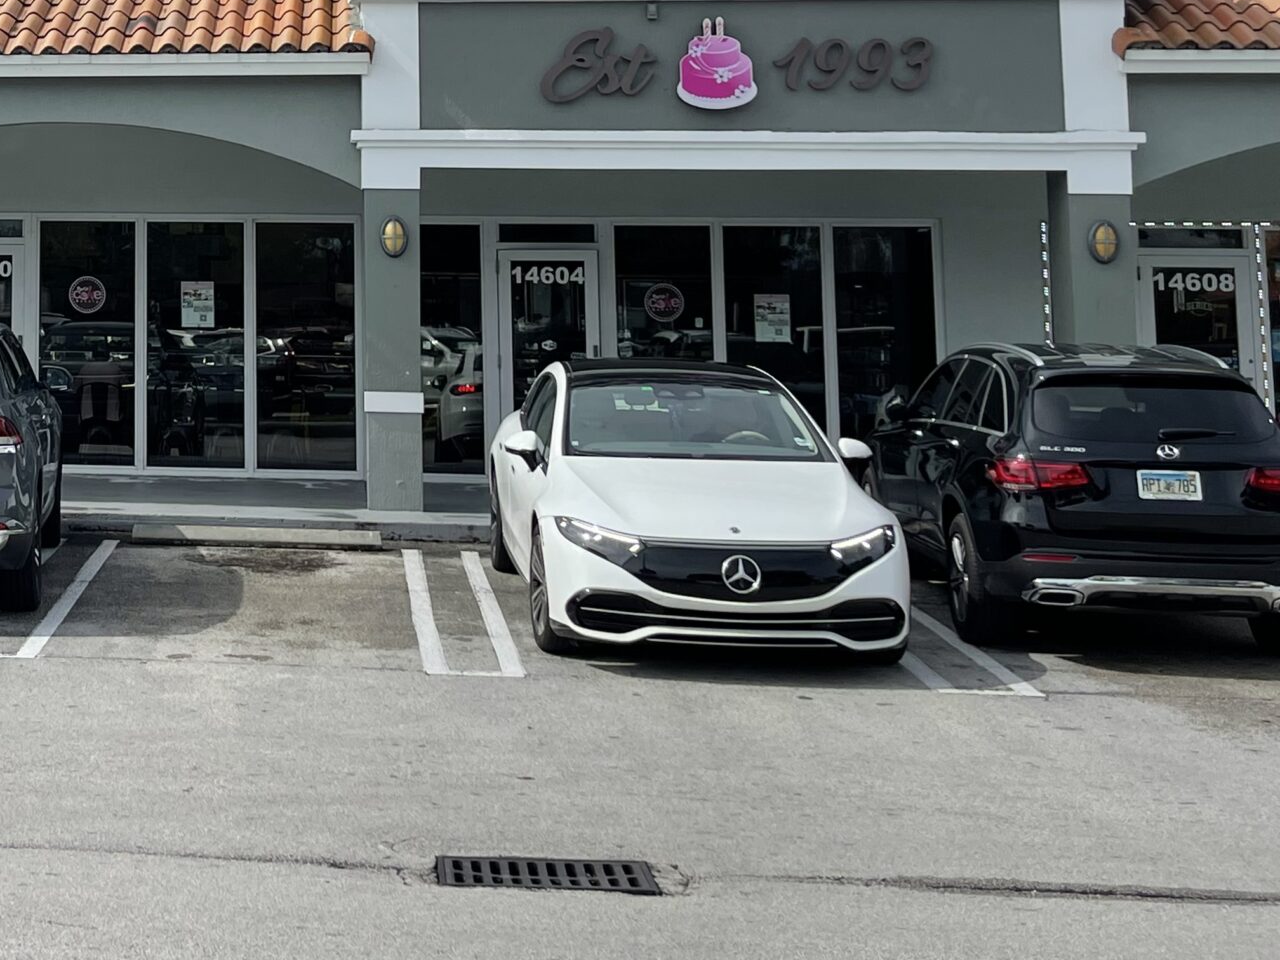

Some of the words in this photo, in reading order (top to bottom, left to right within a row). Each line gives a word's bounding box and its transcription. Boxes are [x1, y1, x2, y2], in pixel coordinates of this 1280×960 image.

[540, 26, 658, 104] Est
[773, 37, 935, 92] 1993
[511, 266, 585, 285] 14604
[1152, 272, 1235, 292] 14608
